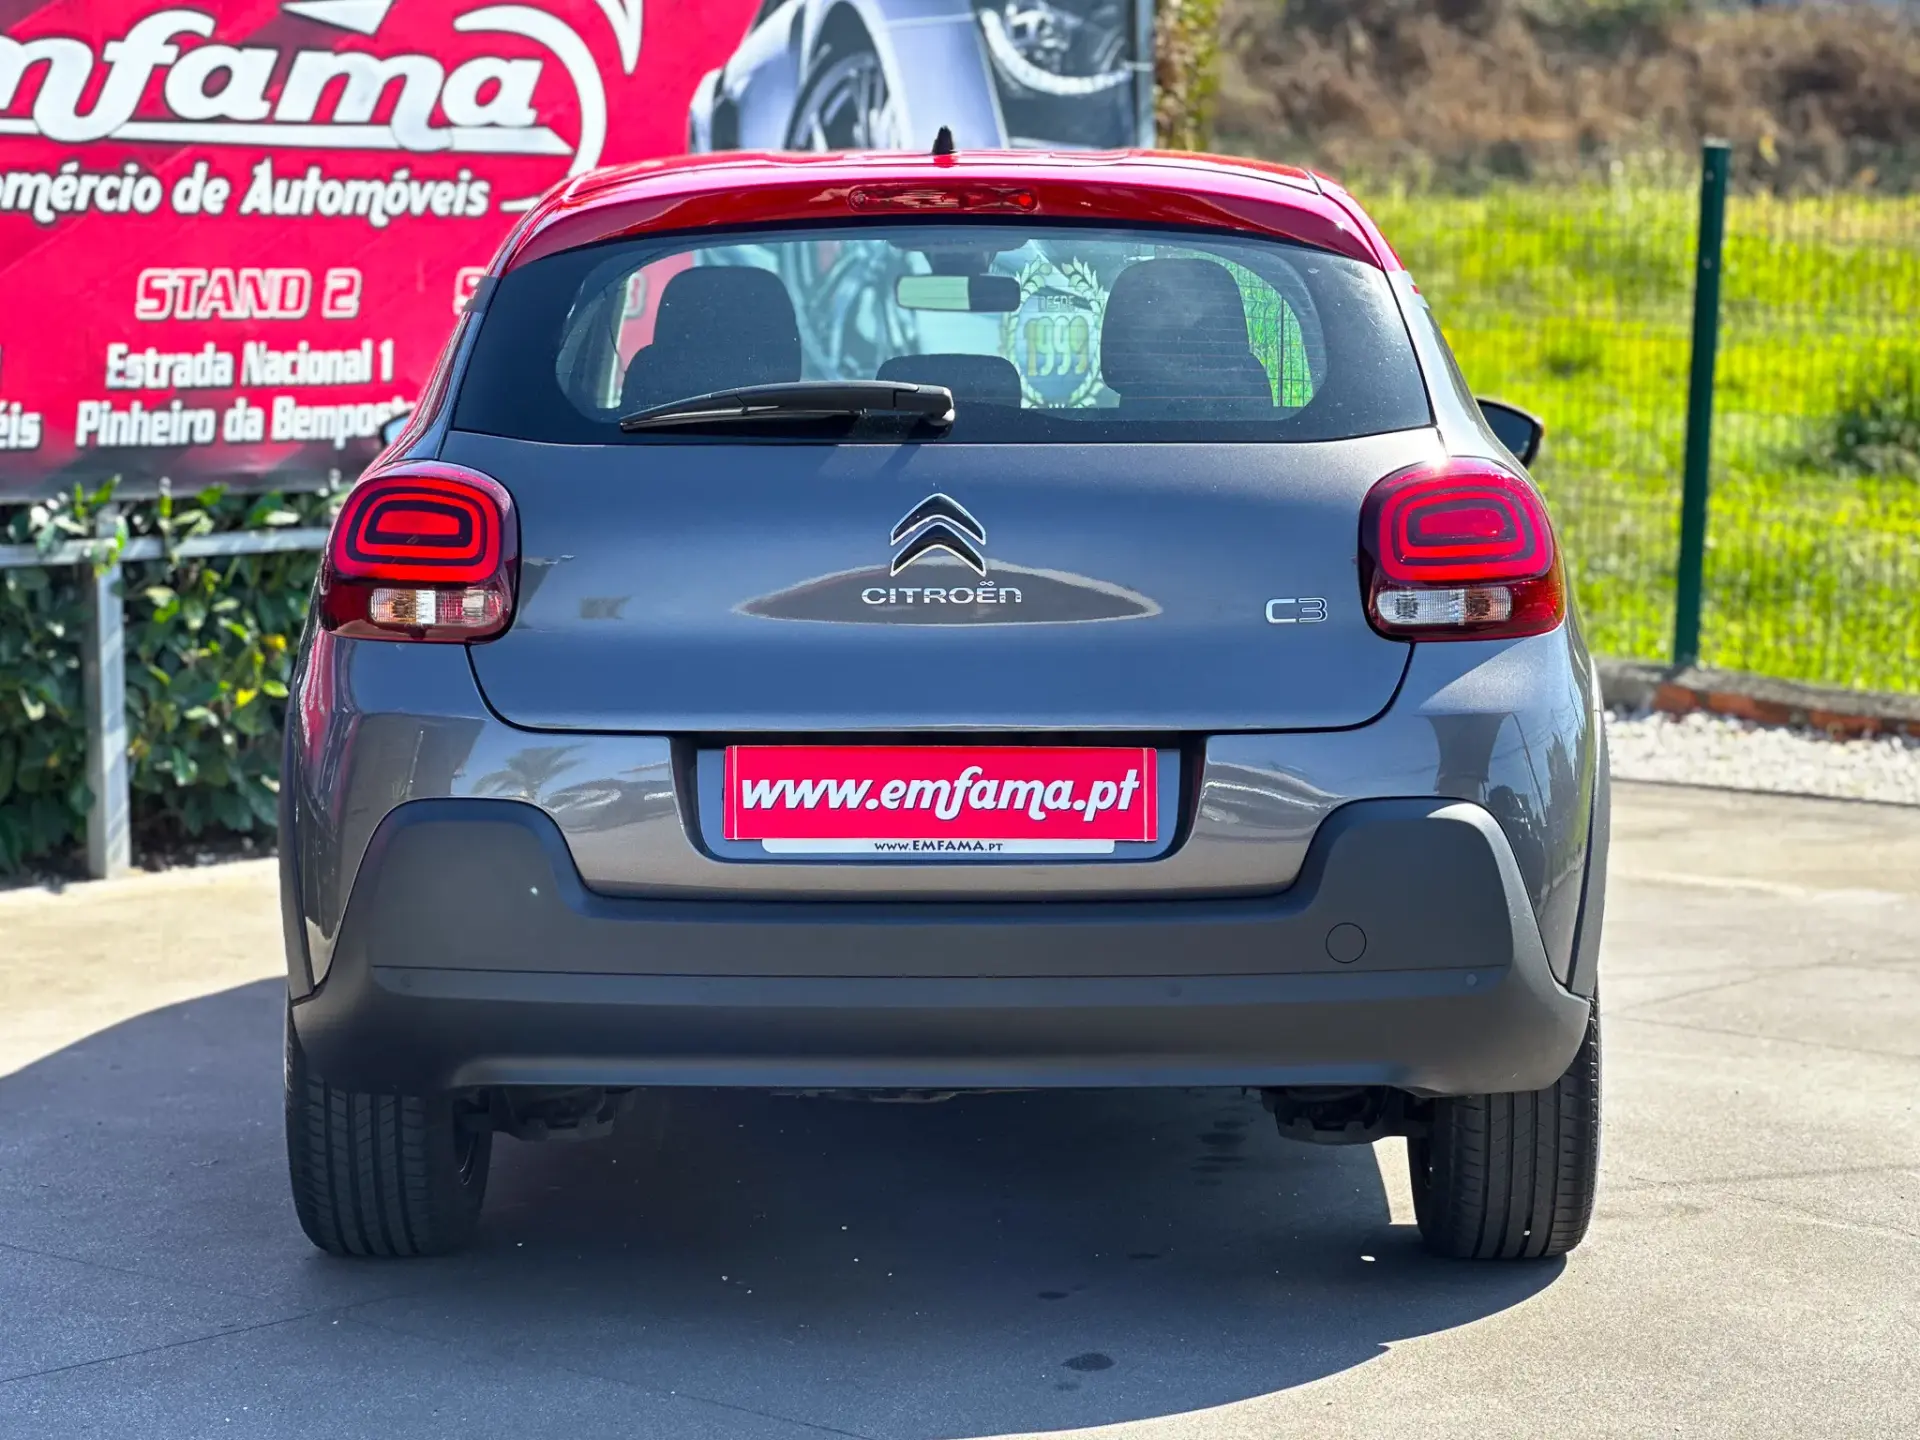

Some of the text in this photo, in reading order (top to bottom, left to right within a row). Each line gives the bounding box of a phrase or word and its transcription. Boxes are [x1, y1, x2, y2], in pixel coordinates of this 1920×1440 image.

[0, 156, 489, 227] mércio de Automóveis
[135, 267, 362, 320] STAND 2
[105, 337, 394, 389] Estrada Nacional 1
[1024, 315, 1089, 377] 1999
[75, 395, 416, 449] Pinheiro da Bempos
[1265, 597, 1328, 624] C3
[741, 765, 1140, 822] www.emfama.pt
